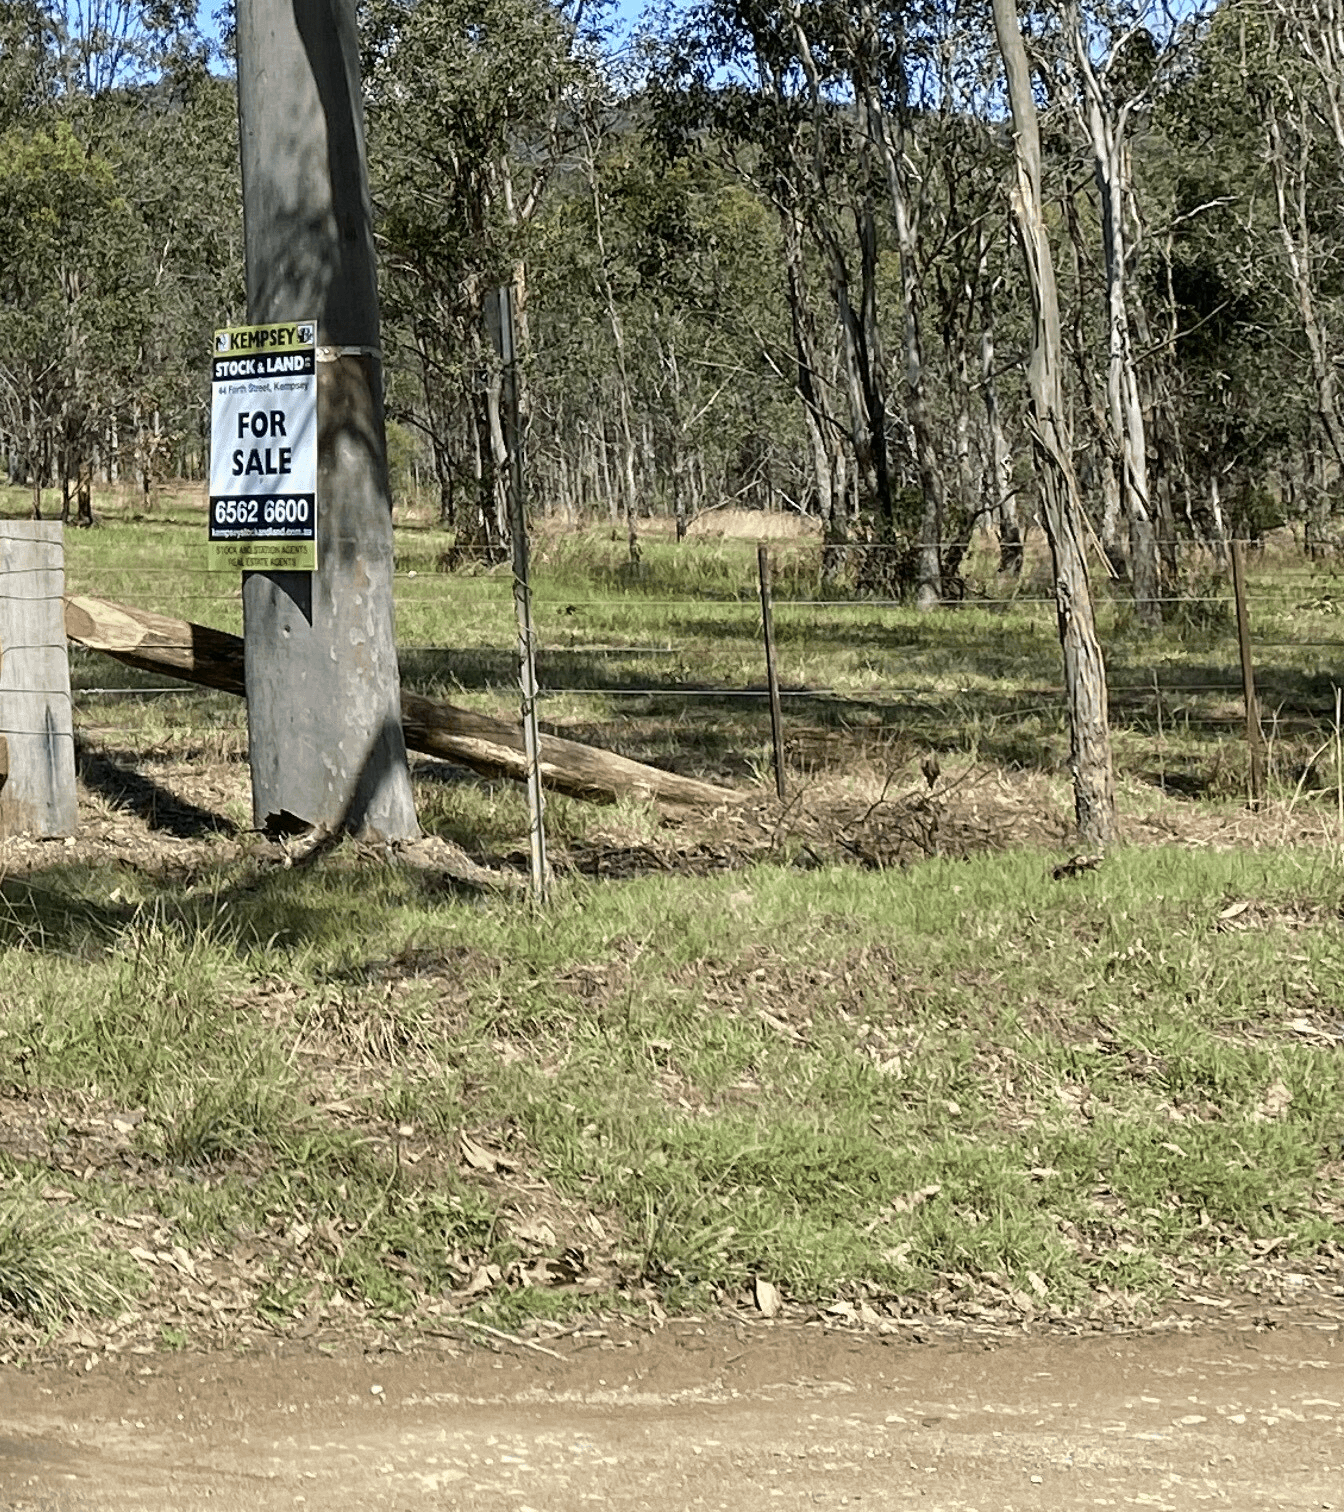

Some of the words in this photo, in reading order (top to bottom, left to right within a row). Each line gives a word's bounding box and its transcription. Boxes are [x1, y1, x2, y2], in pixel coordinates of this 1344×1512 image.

[231, 327, 296, 350] KEMPSEY
[215, 359, 255, 377] STOCK
[257, 361, 265, 374] &
[267, 355, 304, 373] LAND
[238, 410, 287, 439] FOR
[232, 447, 292, 476] SALE
[215, 500, 258, 524] 6562
[264, 498, 308, 523] 6600
